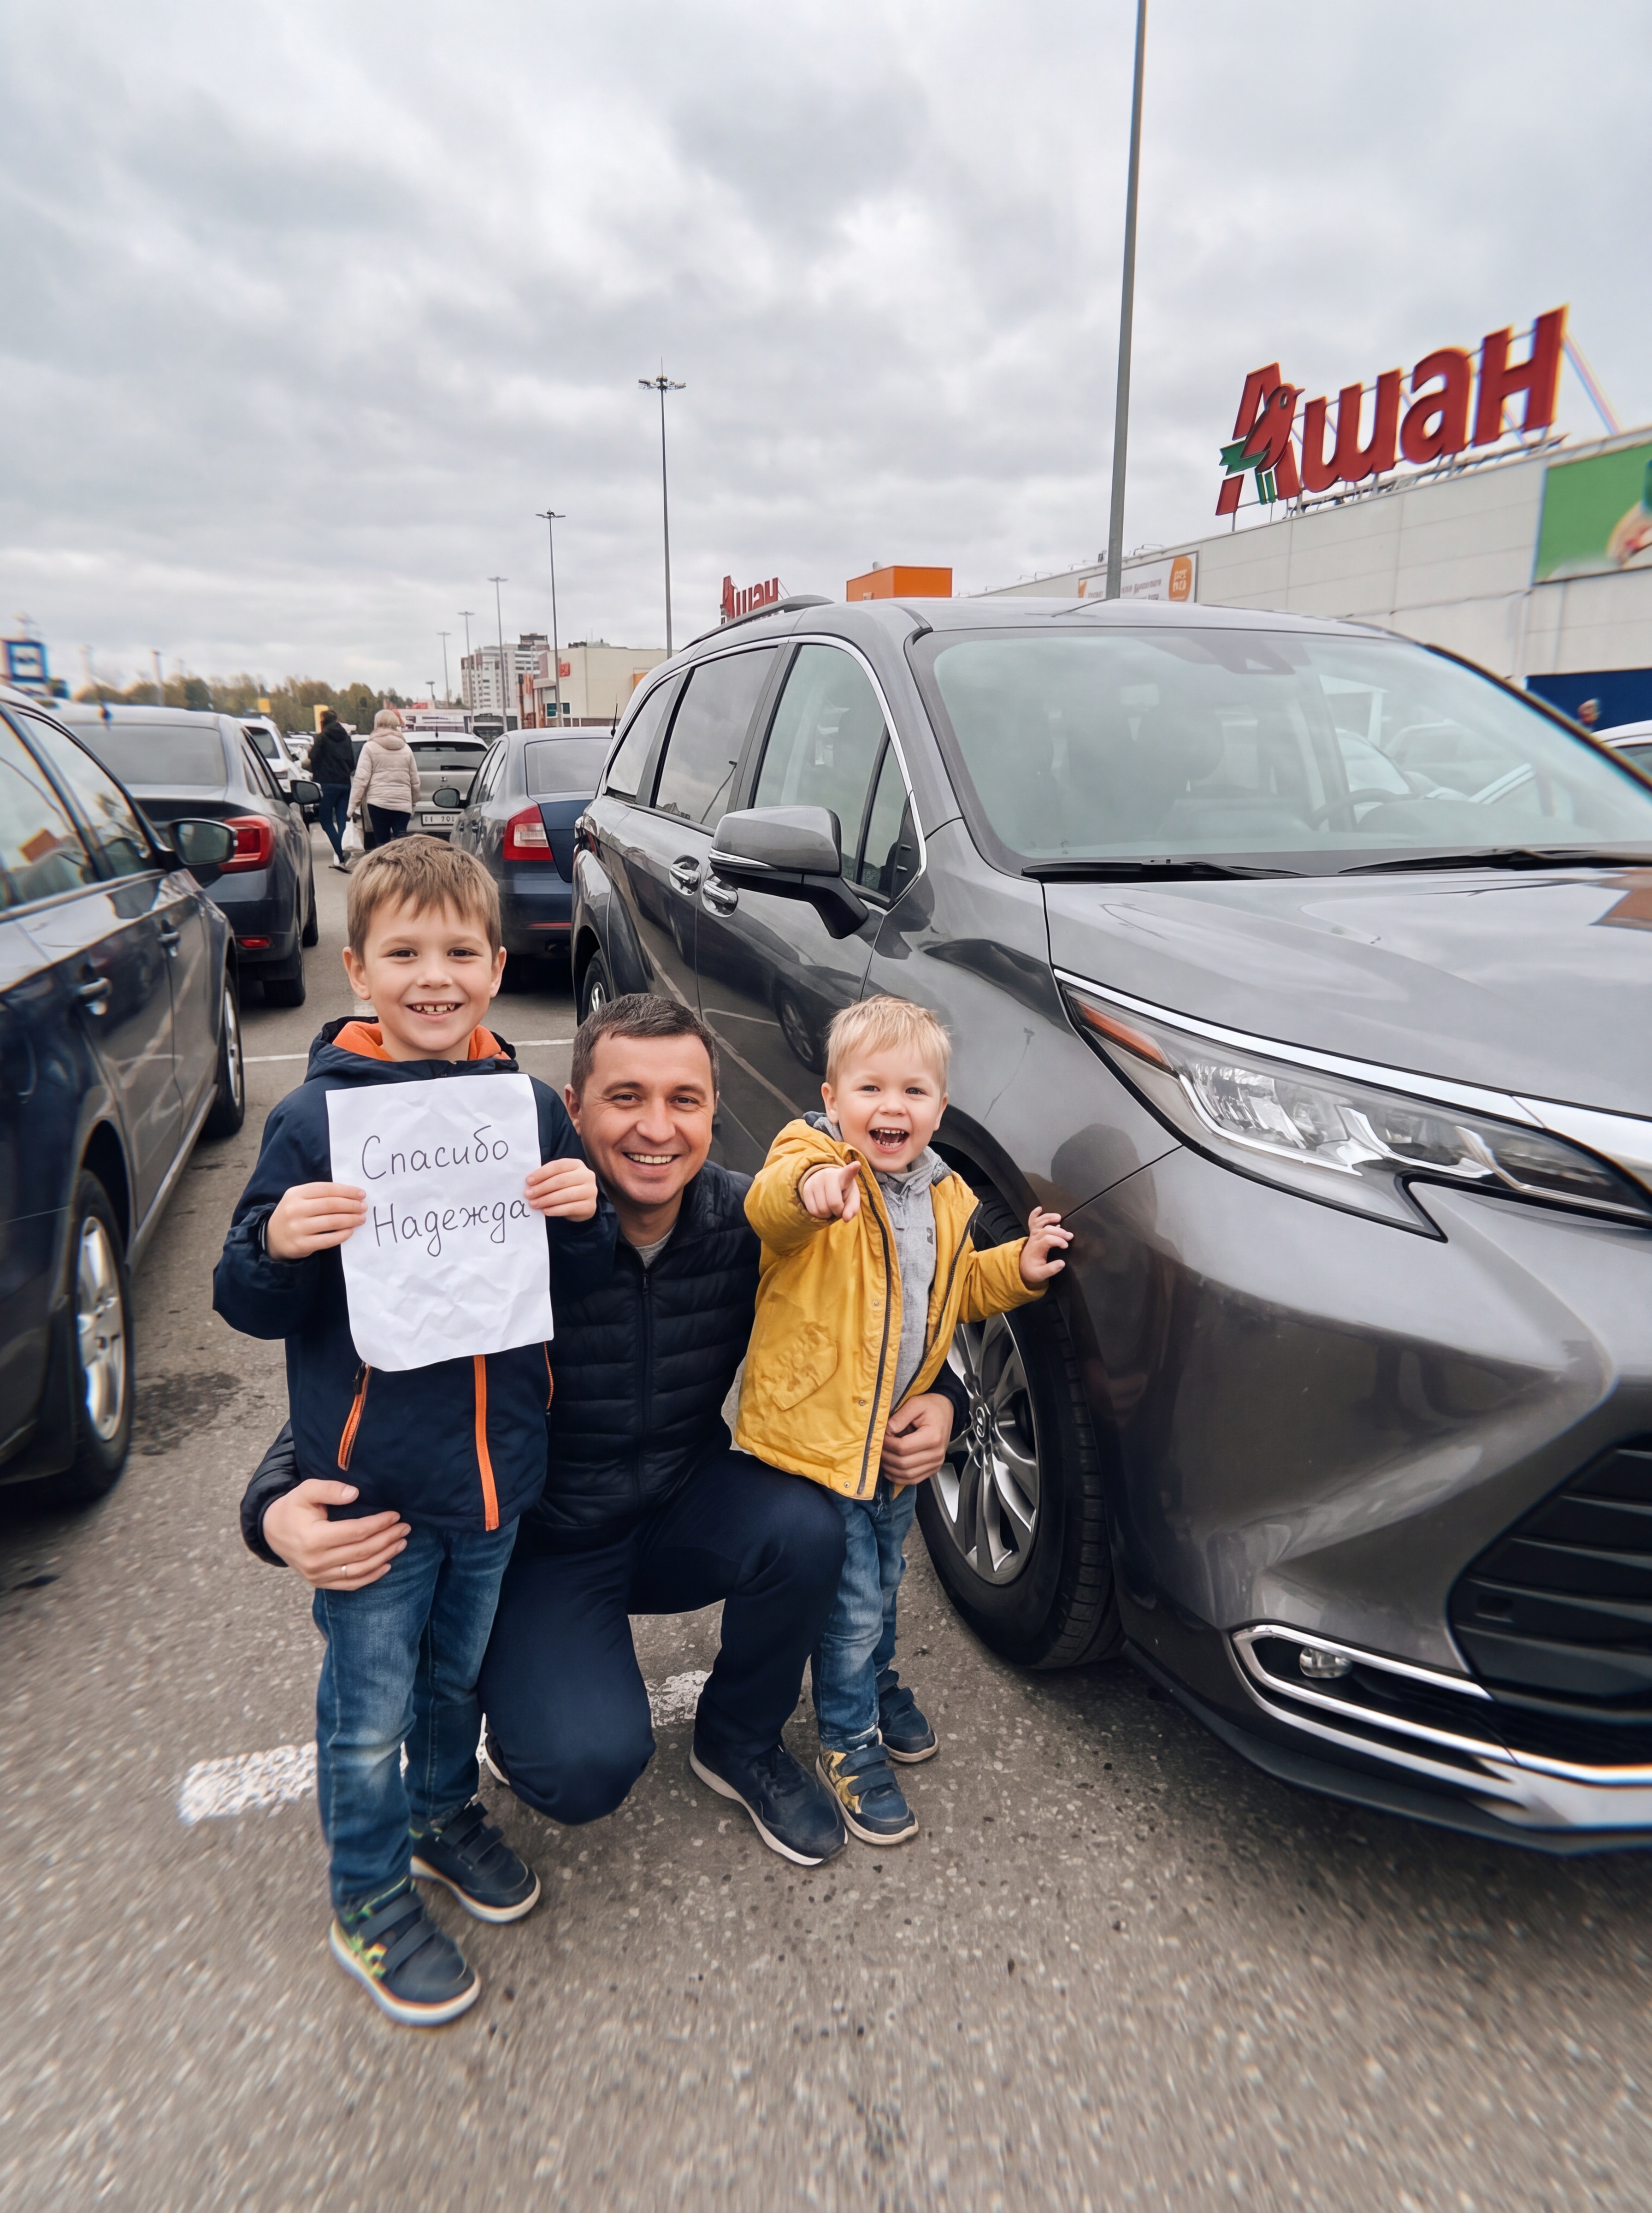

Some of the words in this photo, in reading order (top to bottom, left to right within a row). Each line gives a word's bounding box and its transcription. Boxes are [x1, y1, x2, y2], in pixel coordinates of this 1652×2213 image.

[1215, 304, 1568, 515] Ашан
[362, 1125, 509, 1179] Спасибо
[373, 1200, 531, 1256] Надежда
